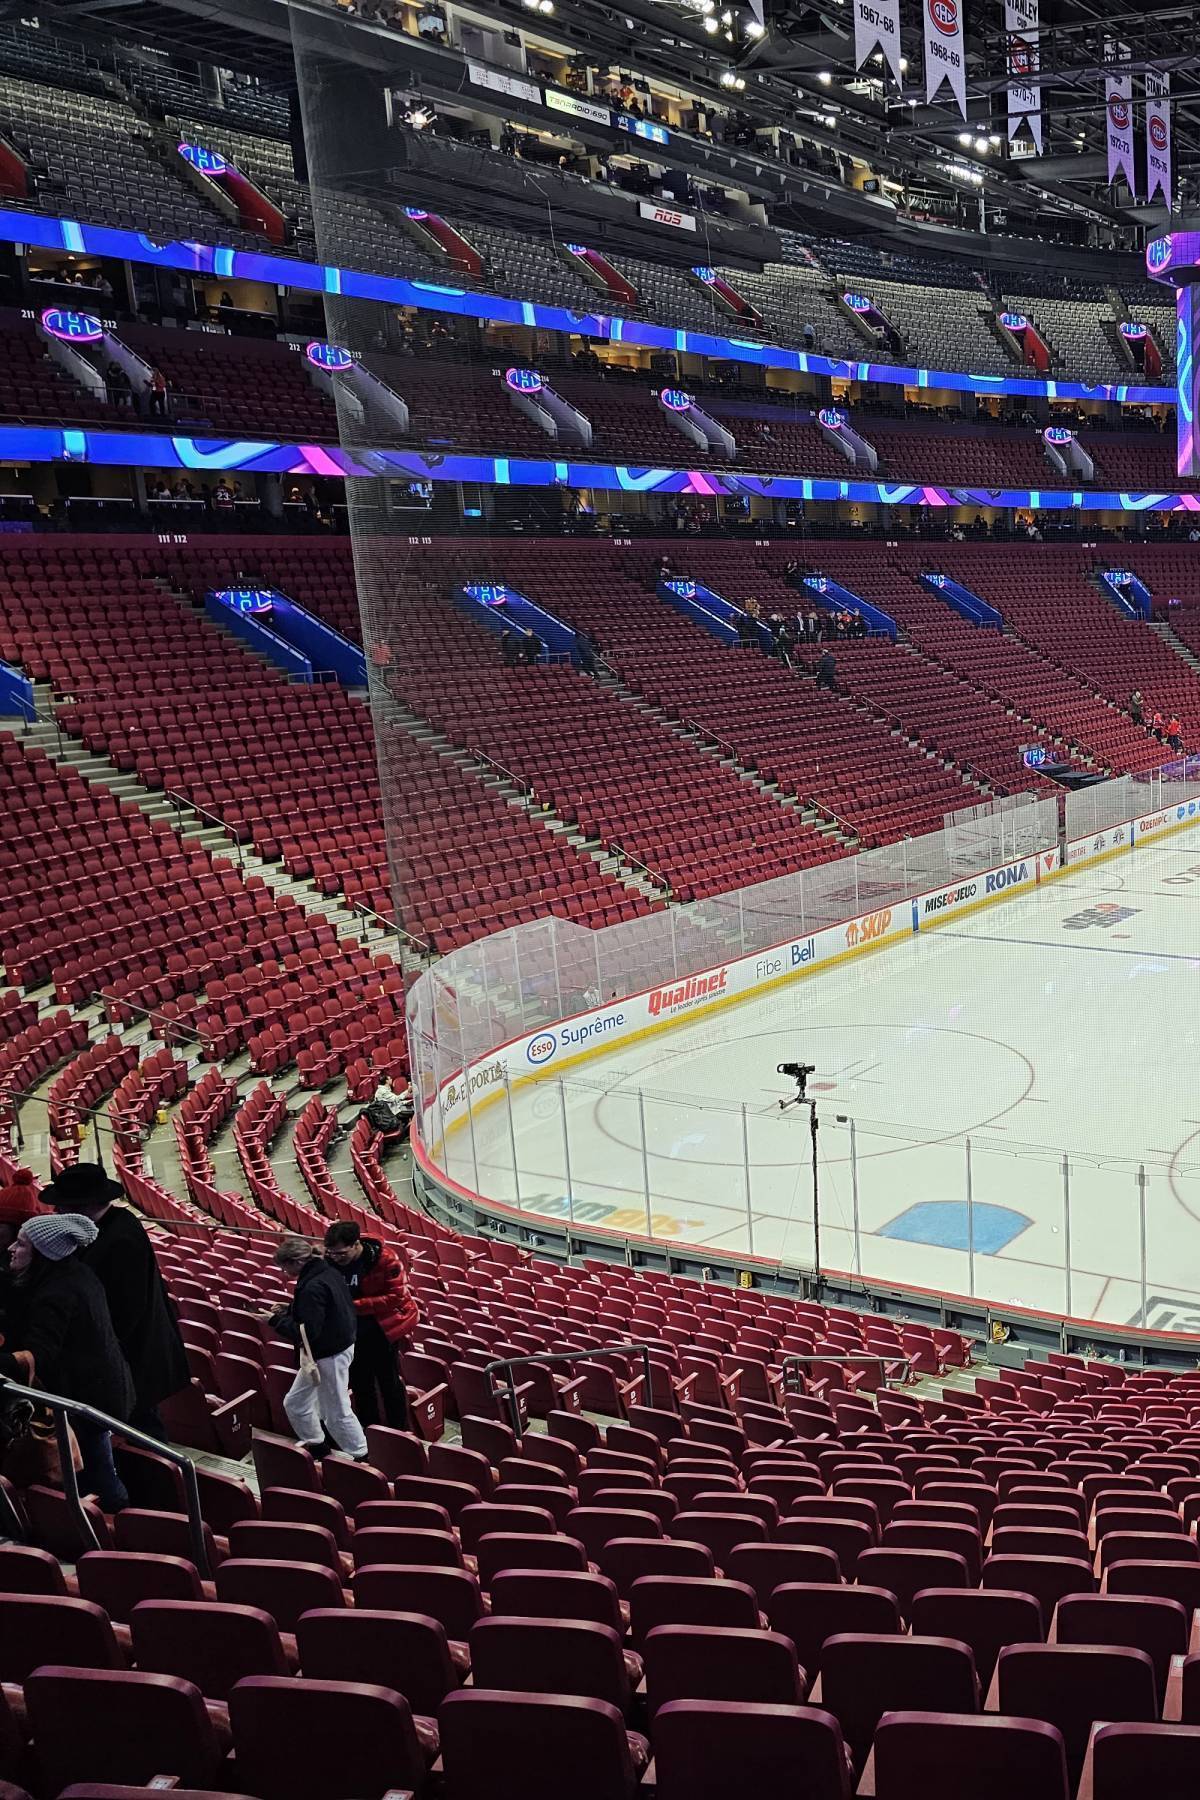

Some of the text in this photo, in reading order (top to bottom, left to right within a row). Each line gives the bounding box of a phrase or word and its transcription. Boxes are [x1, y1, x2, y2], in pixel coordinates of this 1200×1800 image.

[859, 3, 894, 34] 1967-68
[930, 40, 960, 68] 1968-69
[1110, 134, 1130, 154] 1972-73
[654, 209, 682, 226] RDS
[21, 310, 35, 319] 211
[102, 320, 118, 329] 212
[289, 343, 301, 351] 212
[158, 535, 188, 544] 111 112
[986, 863, 1029, 893] RONA
[859, 909, 892, 943] SKIP
[756, 938, 816, 979] Fibe Bell
[647, 968, 728, 1016] Qualinet
[561, 1012, 625, 1046] Suprême
[520, 1397, 526, 1407] F
[573, 1391, 579, 1400] E
[428, 1403, 435, 1412] G
